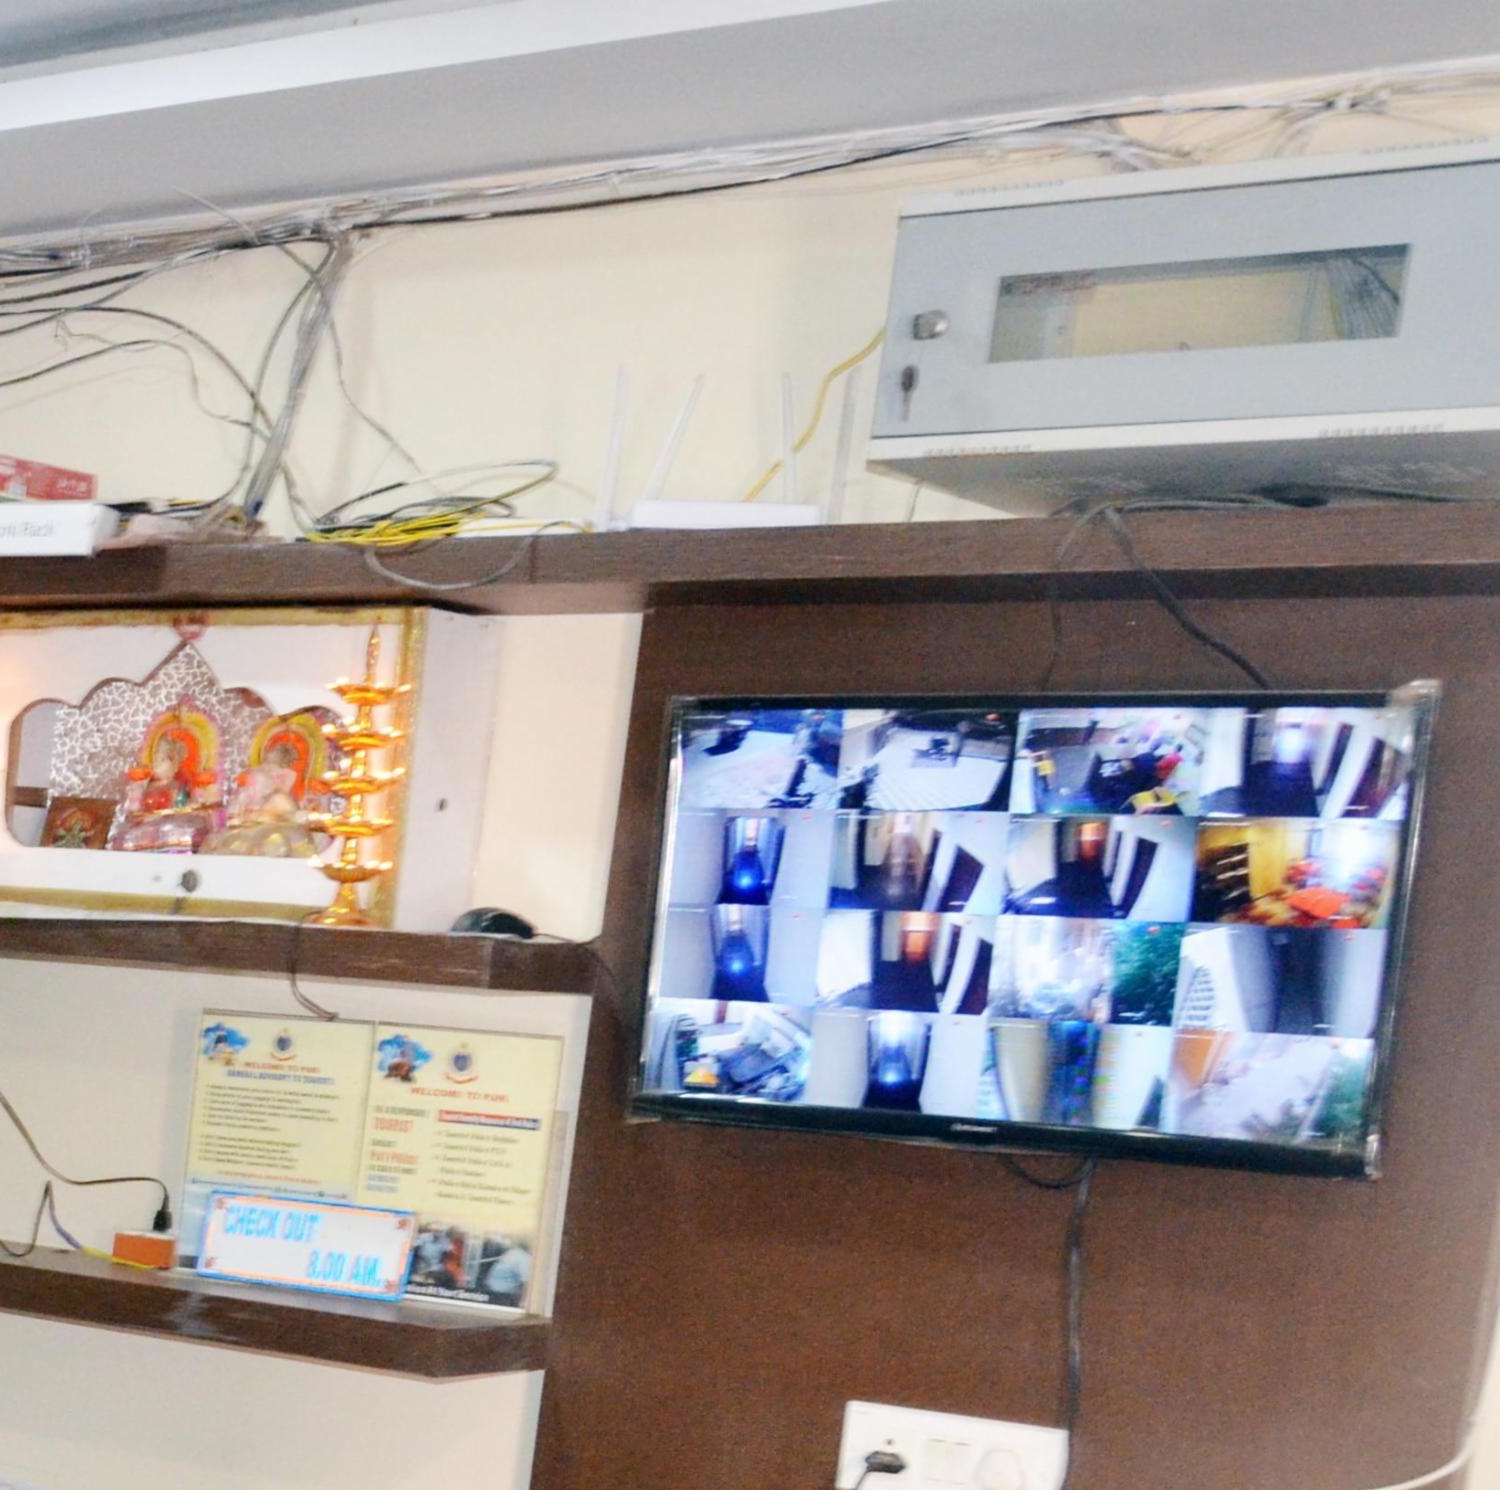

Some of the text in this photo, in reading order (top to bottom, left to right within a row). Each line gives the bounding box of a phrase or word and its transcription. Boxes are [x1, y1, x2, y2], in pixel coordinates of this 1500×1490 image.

[410, 1086, 460, 1099] WELCOME
[224, 1204, 321, 1242] CHECK OUT
[306, 1250, 348, 1280] 8.00
